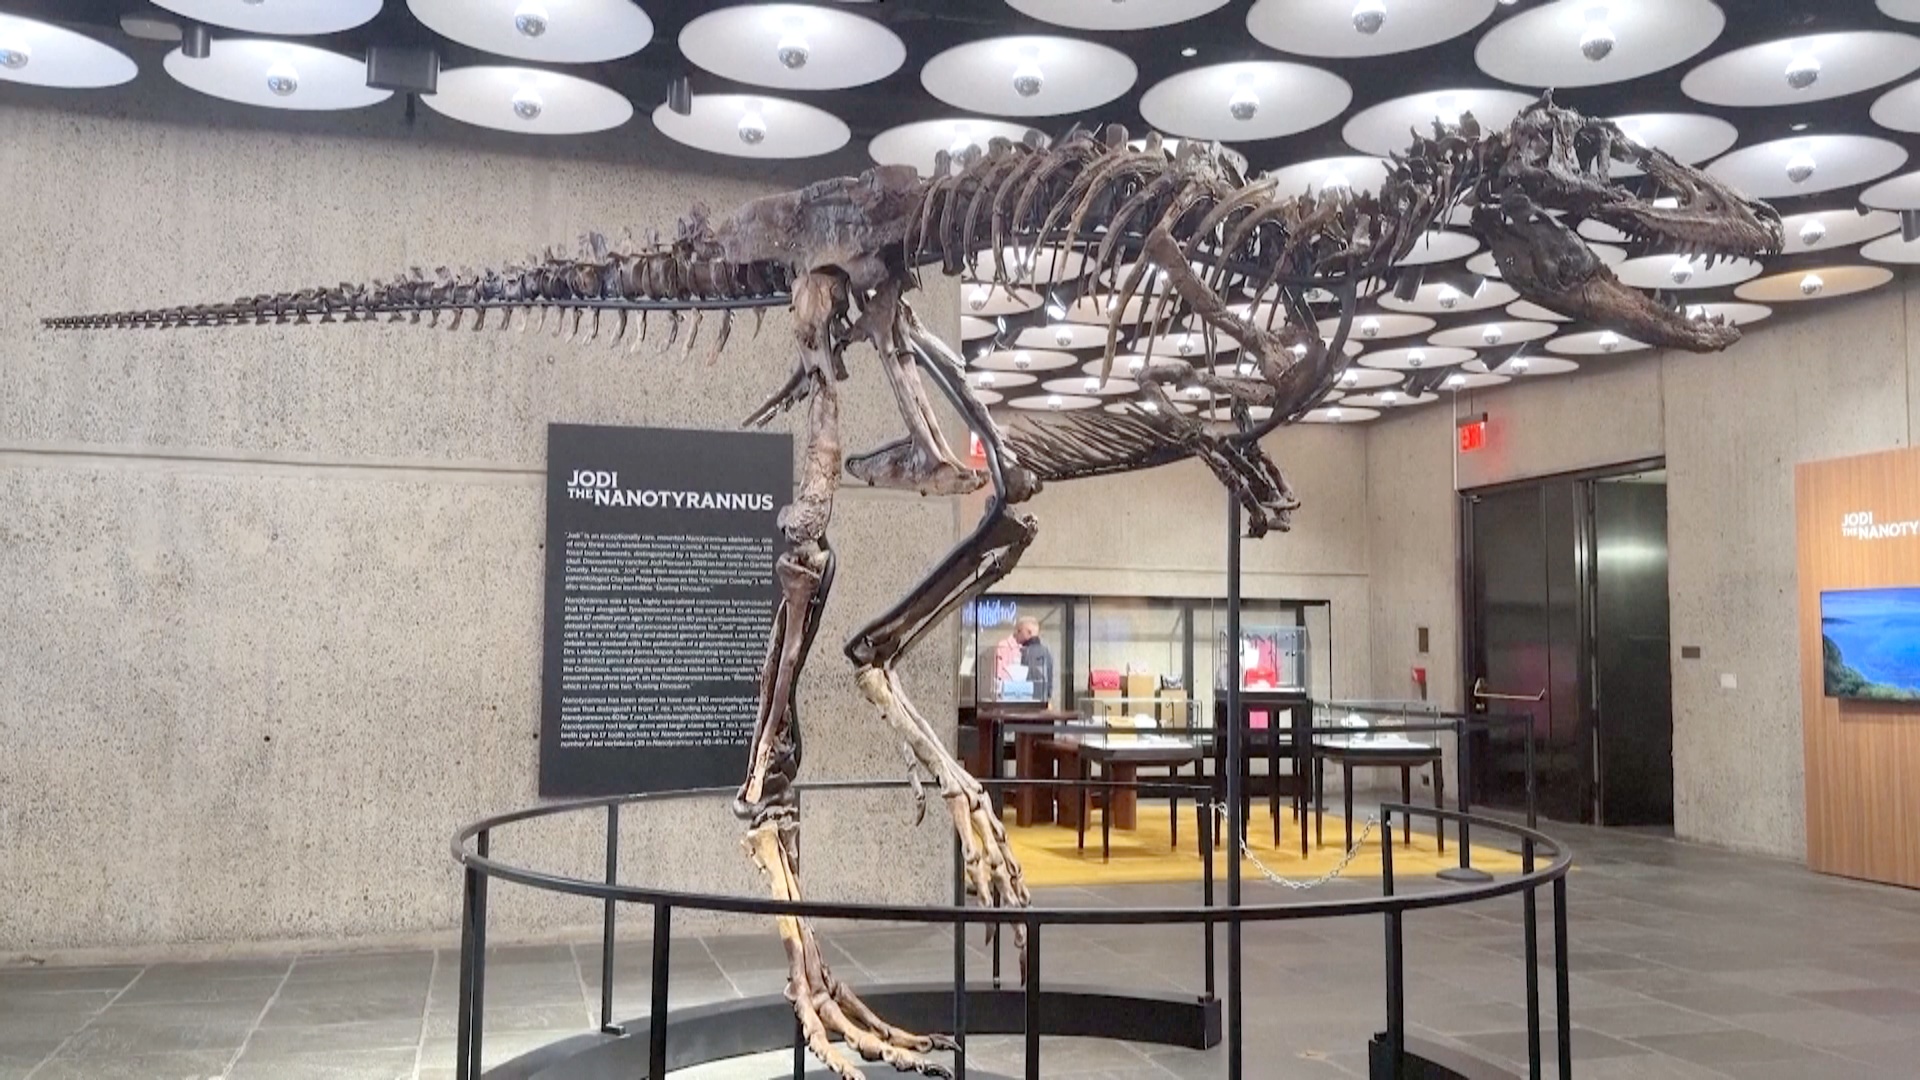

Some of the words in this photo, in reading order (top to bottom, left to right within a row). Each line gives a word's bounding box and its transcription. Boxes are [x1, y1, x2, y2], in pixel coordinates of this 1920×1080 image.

[567, 470, 618, 488] JODI
[567, 488, 594, 499] THE
[594, 490, 774, 510] NANOTYRANNUS
[1841, 511, 1873, 527] JODI
[1842, 526, 1858, 537] THE
[1858, 519, 1920, 540] NANOTY
